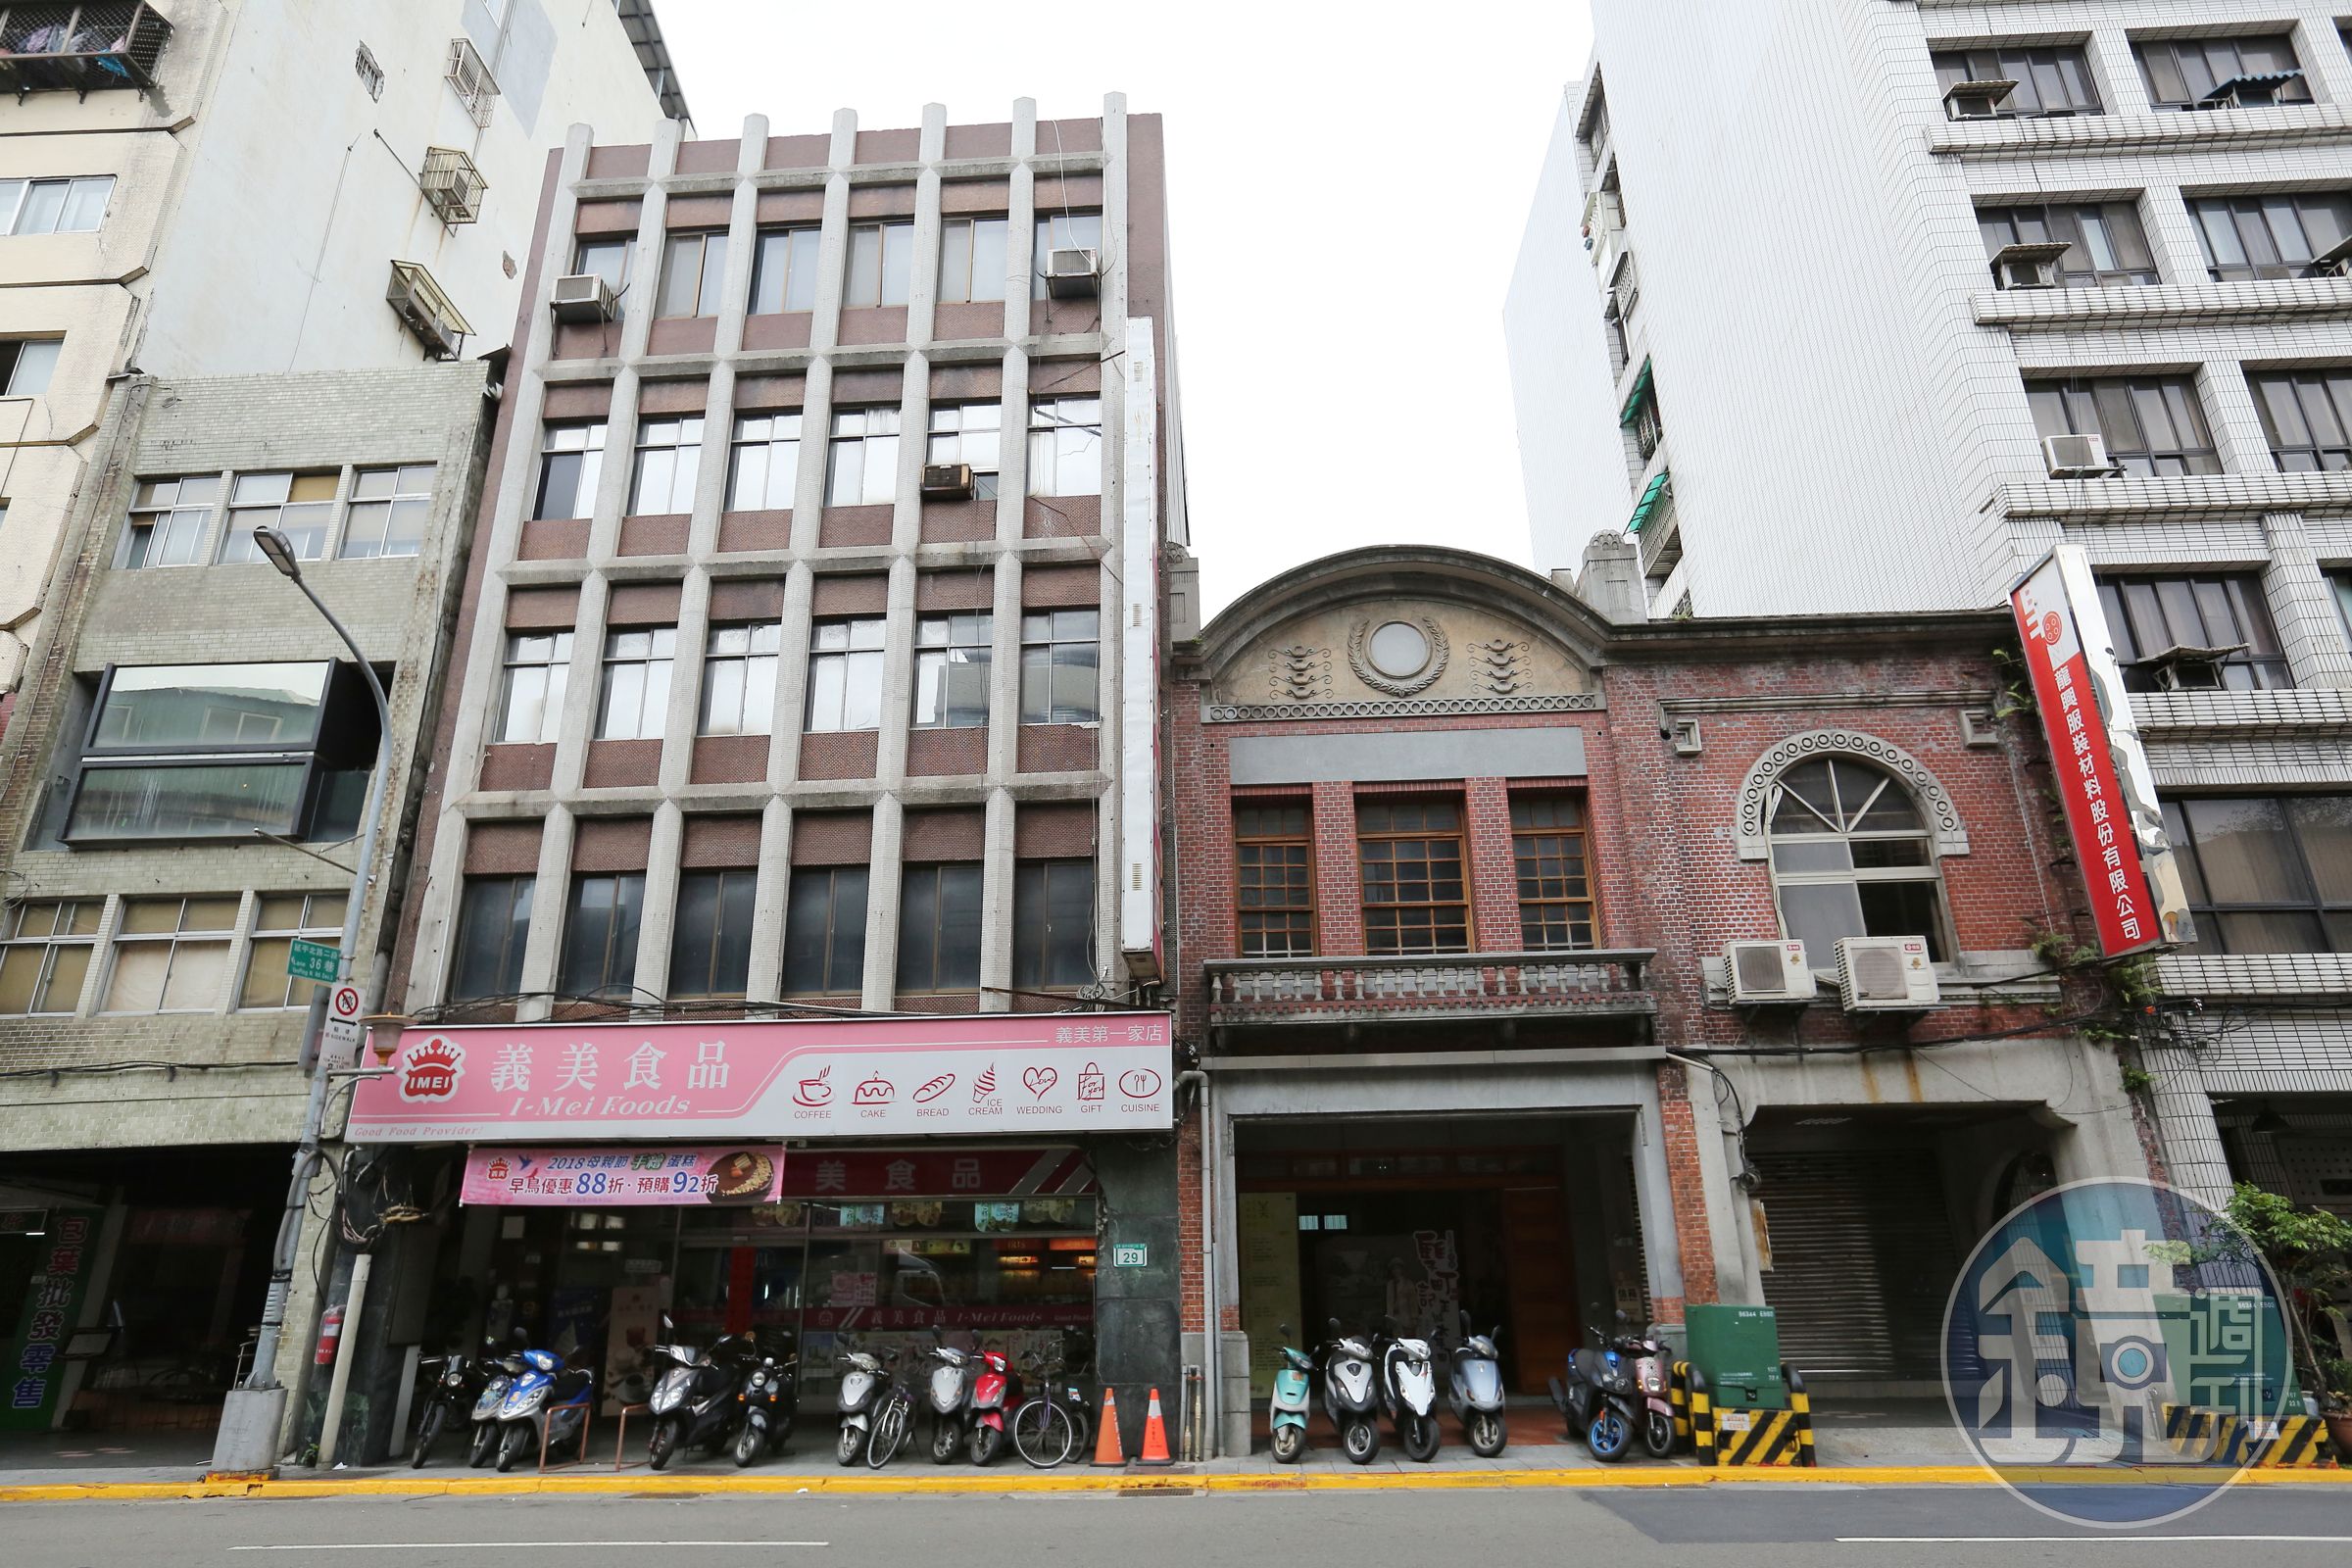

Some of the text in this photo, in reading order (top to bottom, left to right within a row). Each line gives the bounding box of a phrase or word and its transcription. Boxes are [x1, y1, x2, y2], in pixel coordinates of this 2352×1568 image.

[2054, 664, 2141, 941] 龍興服裝材料股份有限公司
[310, 957, 322, 970] 36
[1055, 1024, 1162, 1044] 義美第一家店
[491, 1040, 730, 1092] 義美食品
[409, 1075, 450, 1089] IMEI
[510, 1095, 690, 1116] I-Mei Foods
[1016, 1105, 1062, 1114] WEDDING
[1080, 1104, 1102, 1113] GIFT
[1121, 1103, 1159, 1112] CUISINE
[794, 1109, 831, 1119] COFFEE
[860, 1109, 886, 1118] CAKE
[916, 1108, 949, 1117] BREAD
[354, 1126, 484, 1137] Good Food Provider!
[1123, 1252, 1138, 1263] 29
